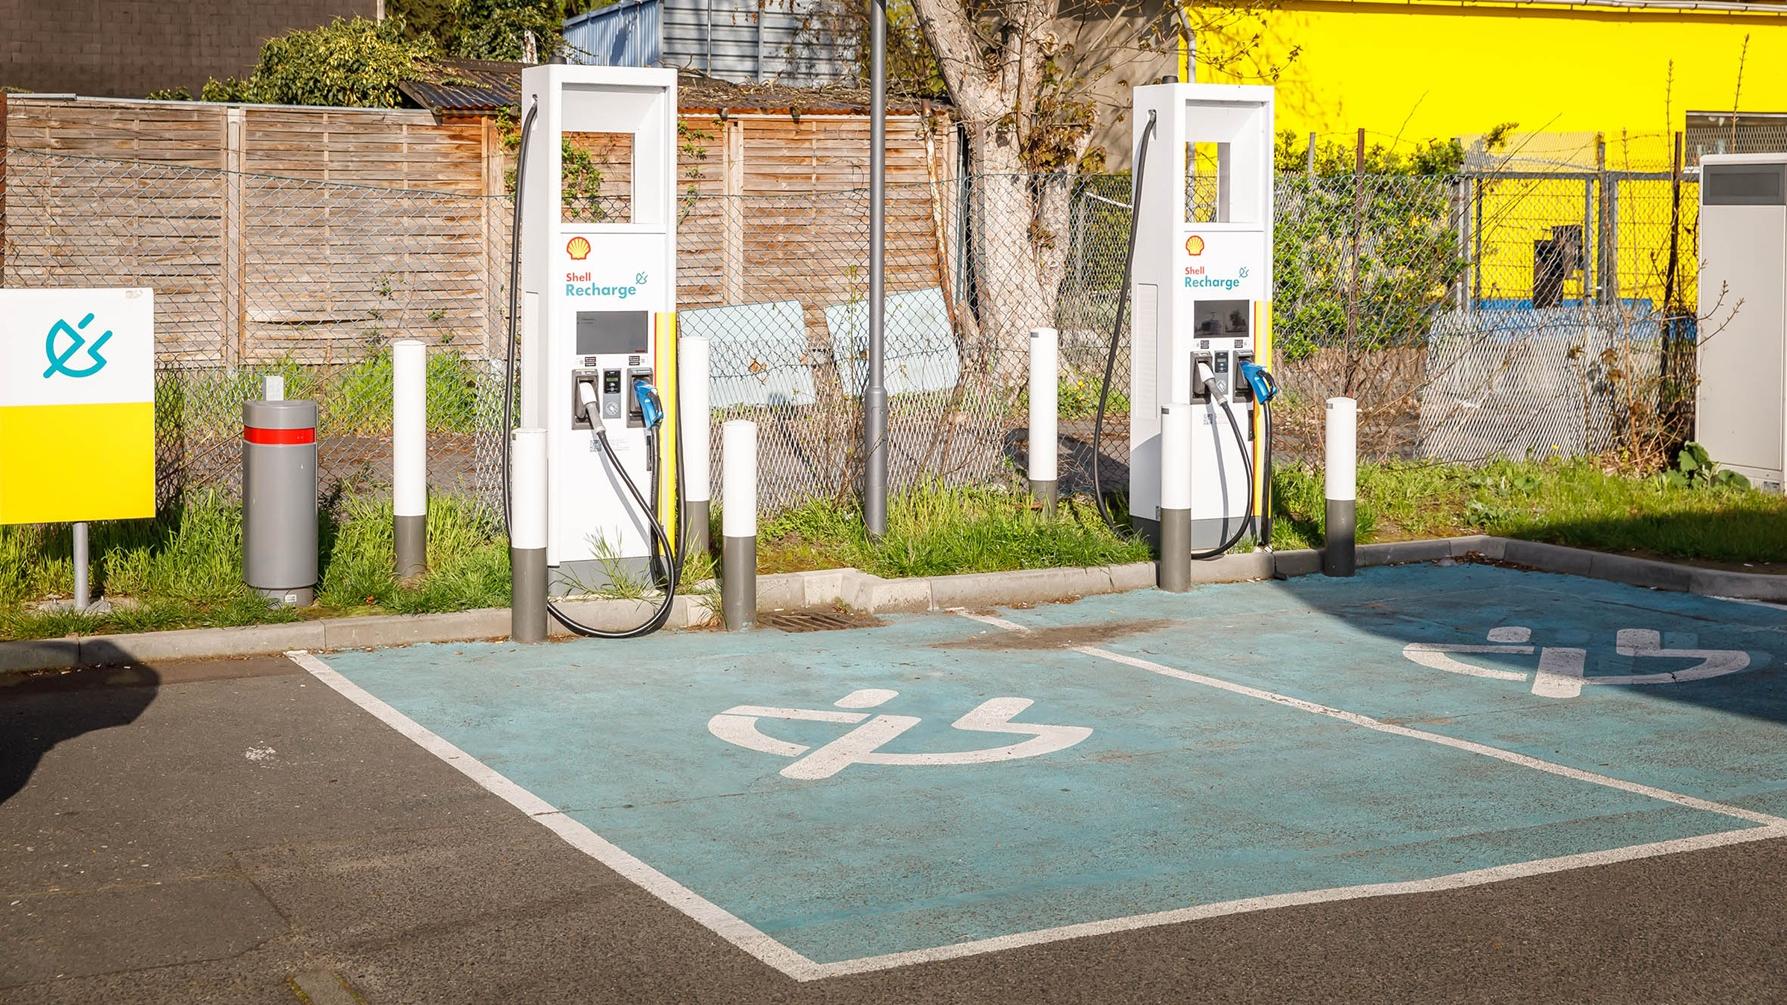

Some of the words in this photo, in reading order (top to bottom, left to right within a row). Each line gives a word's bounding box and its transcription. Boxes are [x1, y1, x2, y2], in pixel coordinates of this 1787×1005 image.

[1184, 266, 1205, 275] Shell
[566, 272, 592, 282] Shell
[1184, 275, 1240, 290] Recharge
[566, 282, 636, 299] Recharge
